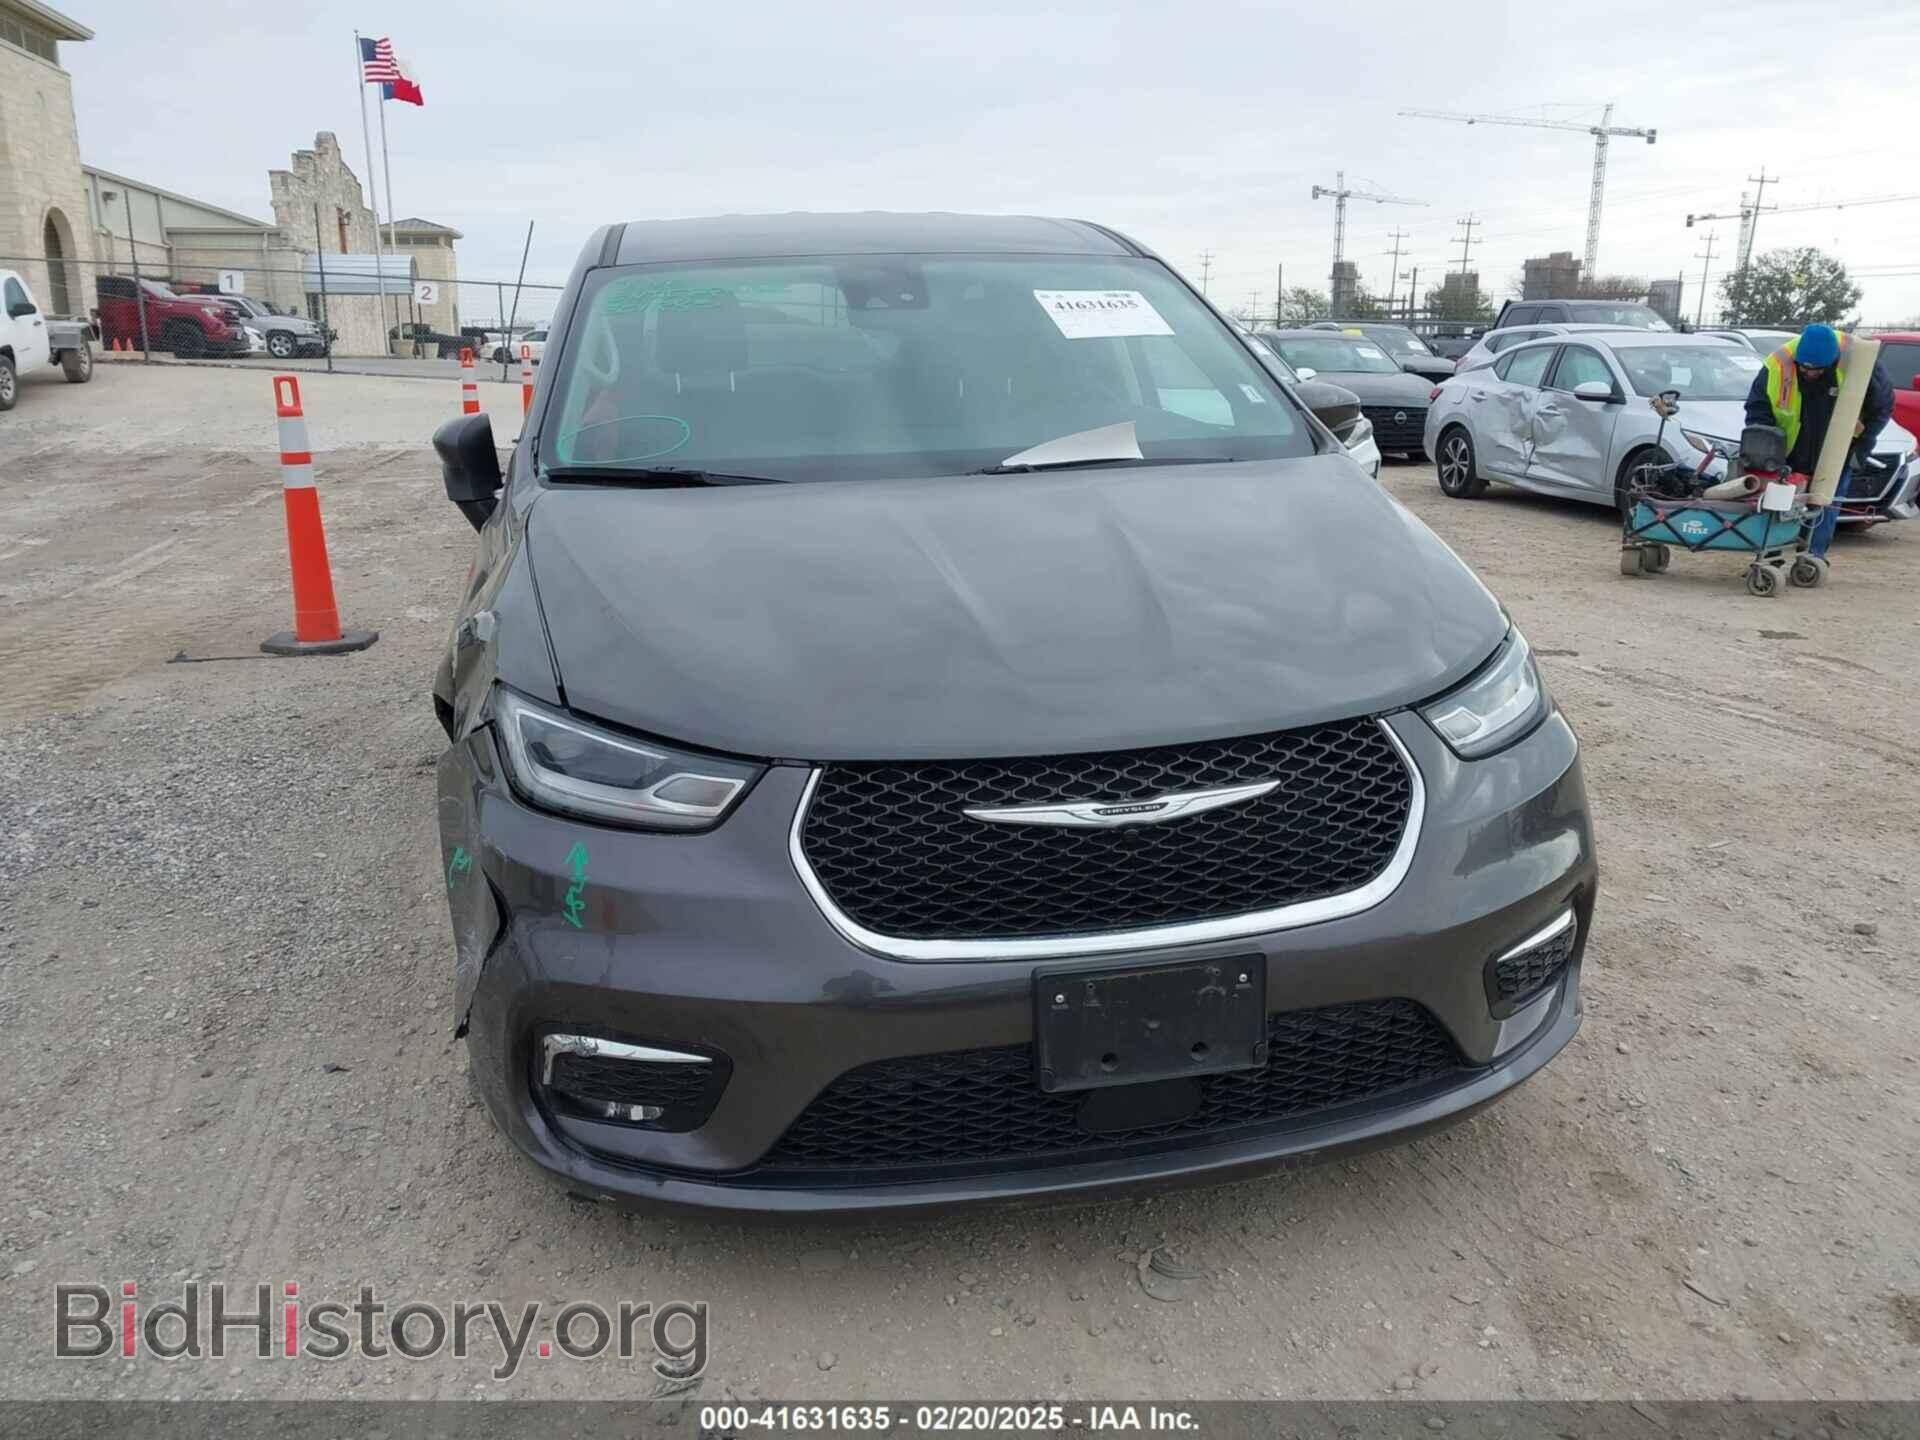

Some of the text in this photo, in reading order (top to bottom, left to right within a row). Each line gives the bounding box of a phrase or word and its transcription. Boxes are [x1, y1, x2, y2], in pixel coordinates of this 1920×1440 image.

[225, 274, 234, 290] 1
[421, 286, 432, 300] 2
[1054, 299, 1139, 311] 41631635
[1099, 803, 1162, 815] CHRYSLER
